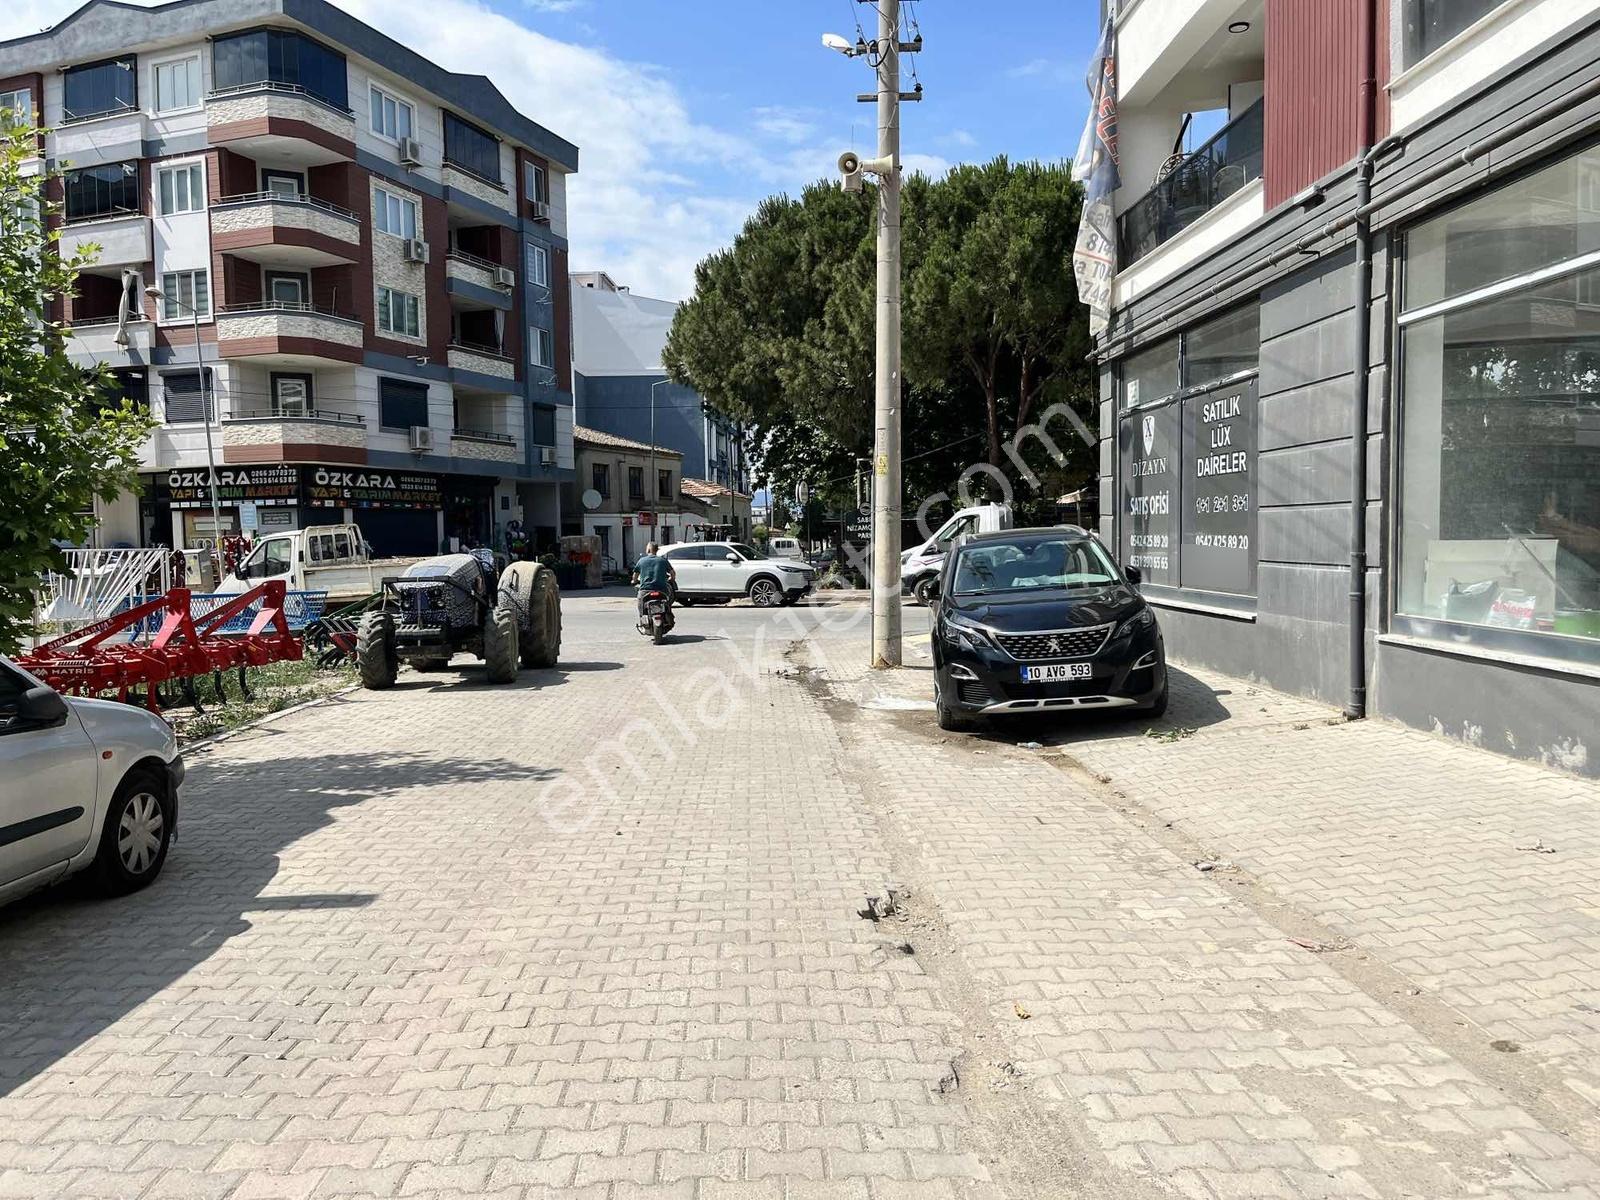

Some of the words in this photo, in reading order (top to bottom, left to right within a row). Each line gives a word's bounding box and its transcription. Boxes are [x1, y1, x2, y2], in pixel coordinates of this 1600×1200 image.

[1202, 395, 1241, 423] SATILIK
[1211, 423, 1231, 448] LÜX
[1132, 457, 1167, 477] DİZAYN
[1197, 452, 1247, 477] DAİRELER
[168, 470, 251, 488] ÖZKARA
[315, 468, 396, 488] ÖZKARA
[170, 488, 195, 498] YAPI
[197, 489, 204, 498] &
[312, 487, 341, 498] YAPI
[343, 488, 351, 498] &
[351, 489, 392, 500] TARIM
[392, 491, 442, 501] MARKET
[1130, 496, 1149, 520] SATIŞ
[1149, 490, 1169, 515] OFİSİ
[1227, 535, 1238, 549] 89
[1238, 535, 1249, 549] 20
[1028, 667, 1041, 679] 10
[1046, 666, 1066, 678] AVG
[1070, 664, 1090, 676] 593
